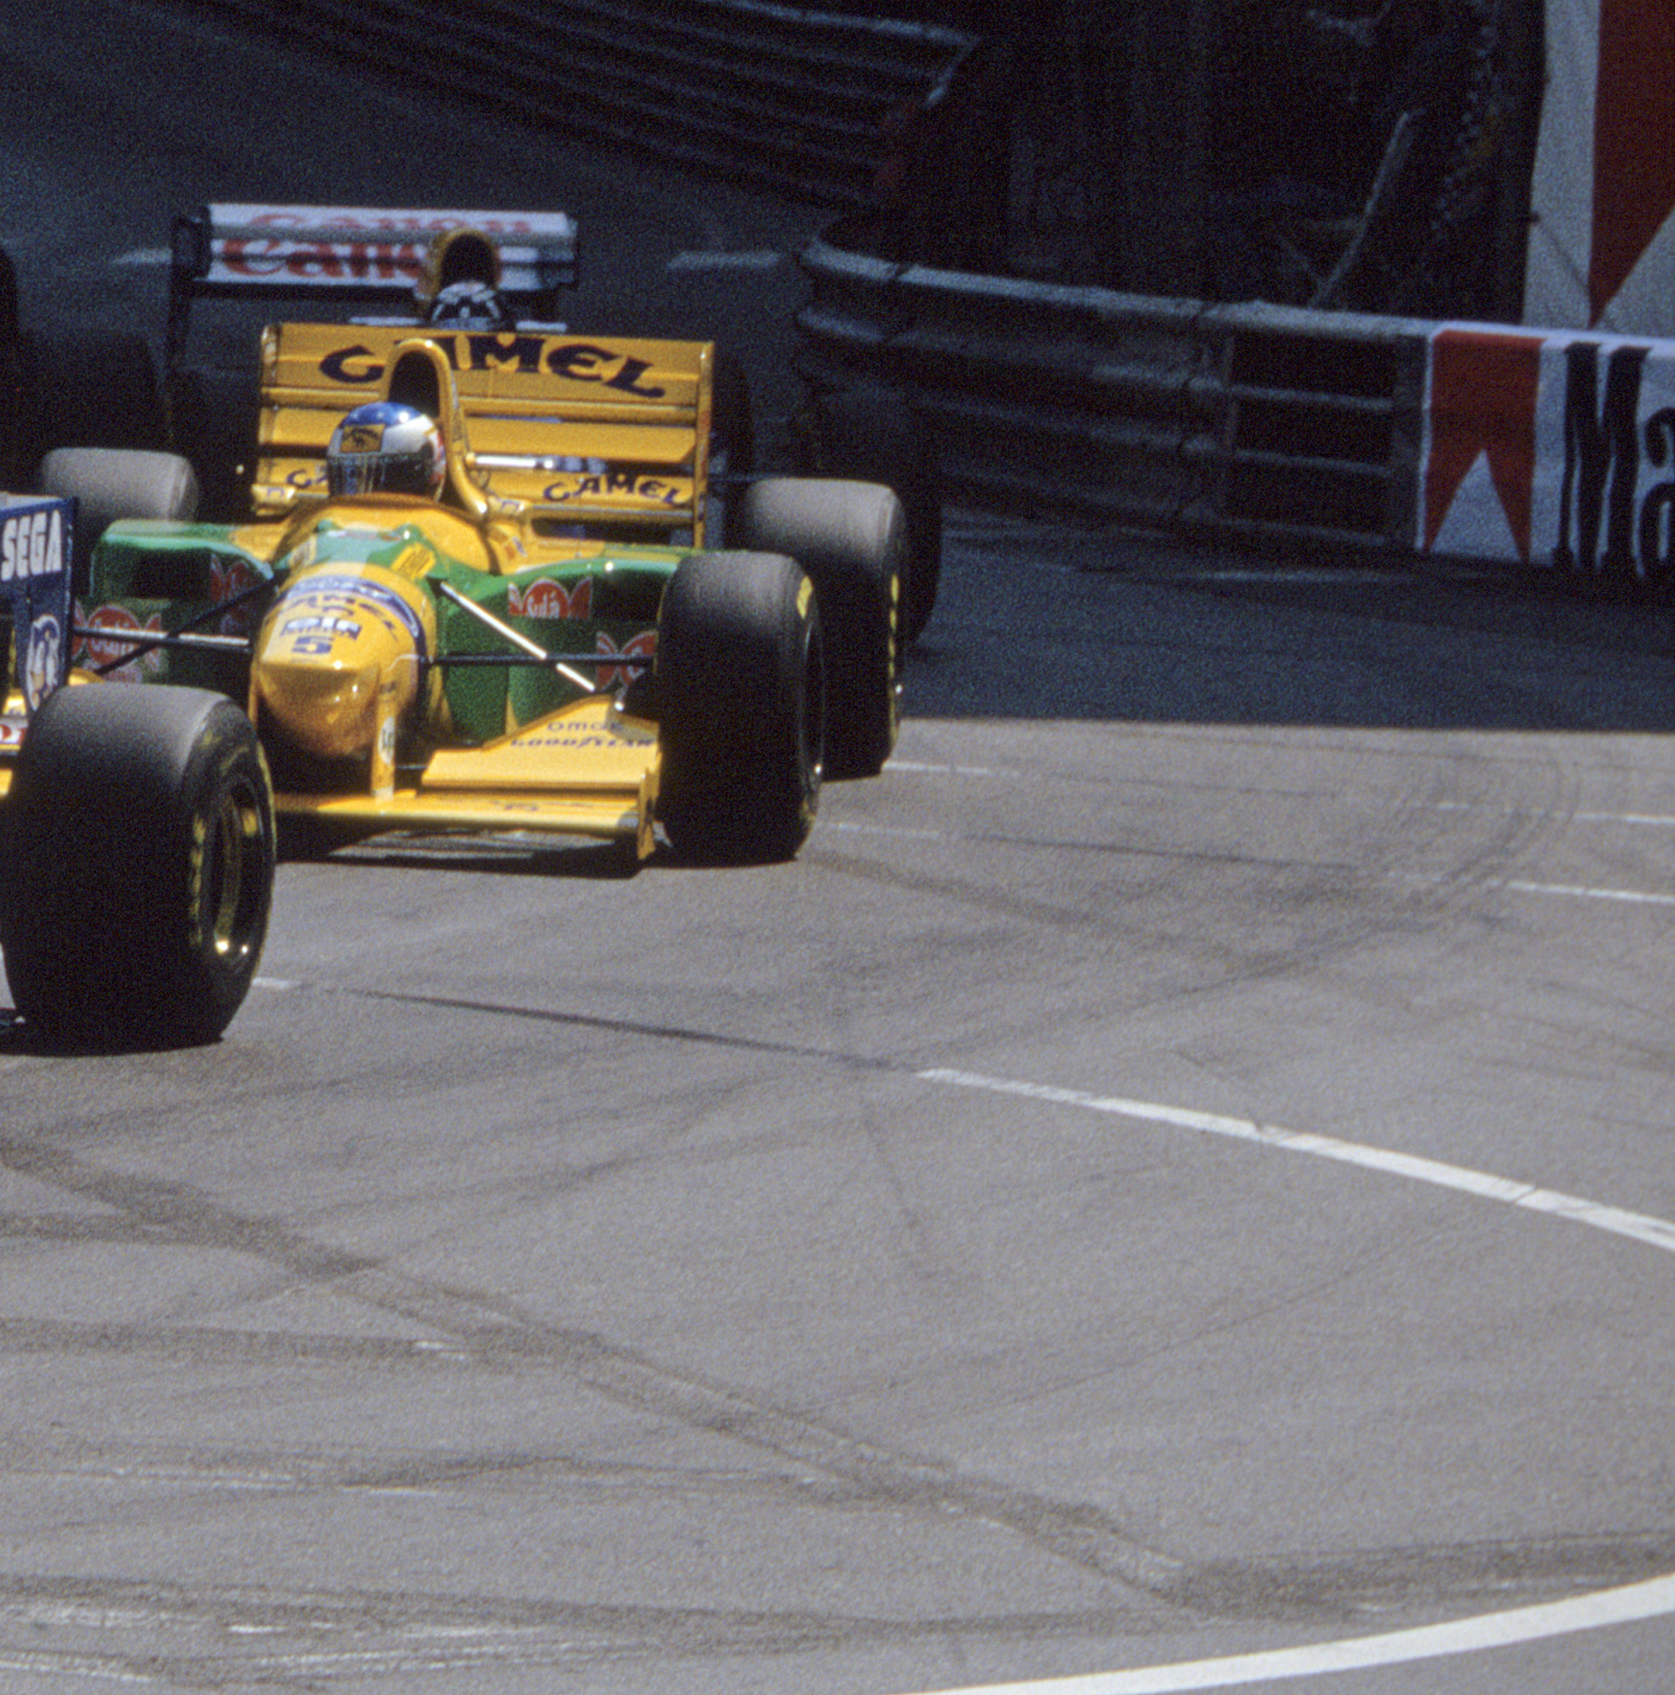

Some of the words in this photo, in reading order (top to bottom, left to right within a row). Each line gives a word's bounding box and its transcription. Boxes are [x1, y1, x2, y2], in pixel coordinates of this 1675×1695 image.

[221, 238, 425, 279] Can
[319, 335, 666, 399] CMEL
[544, 473, 693, 504] CAMEL
[1, 510, 63, 582] SEGA
